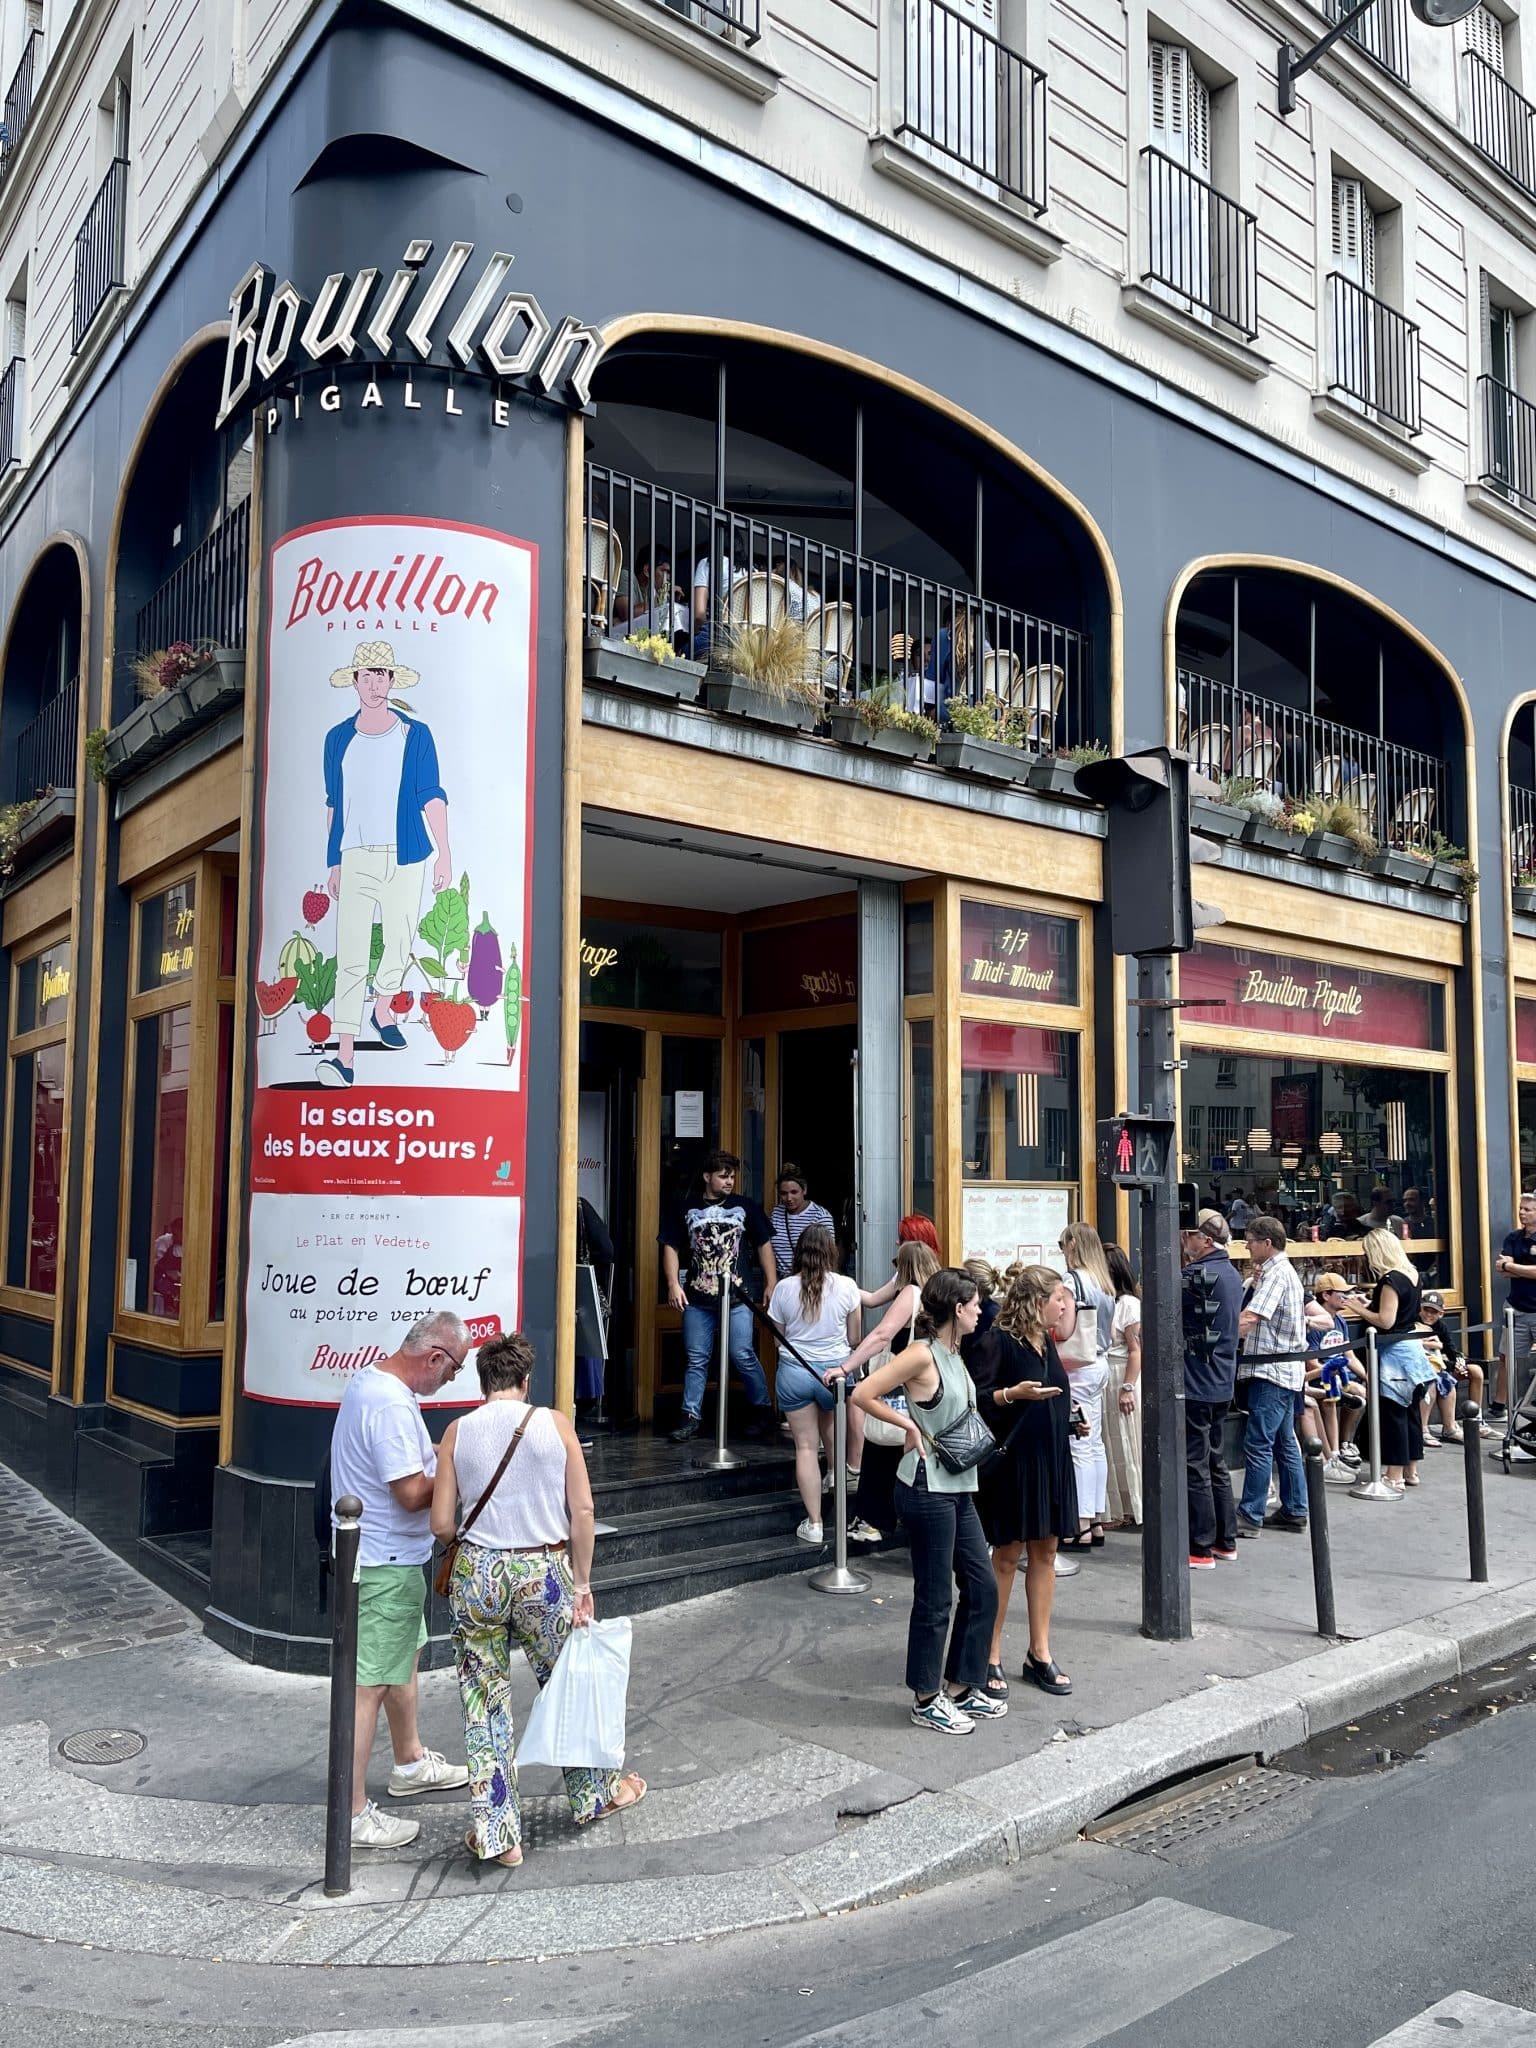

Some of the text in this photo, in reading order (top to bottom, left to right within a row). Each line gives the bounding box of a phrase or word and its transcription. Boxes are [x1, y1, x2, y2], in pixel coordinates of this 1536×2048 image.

[215, 240, 605, 431] Bouillon
[267, 382, 510, 434] PIGALLE
[285, 554, 499, 631] Bouillon
[327, 619, 438, 632] PIGALLE
[1001, 928, 1029, 955] 7/7
[579, 938, 618, 977] tage
[971, 958, 1054, 991] Midi-Minuit
[1241, 969, 1363, 1027] Bouillon Pigalle
[300, 1101, 435, 1127] la saison
[263, 1133, 294, 1157] des
[300, 1132, 390, 1158] beaux
[395, 1133, 477, 1165] jours
[577, 1157, 601, 1170] uillon
[296, 1234, 431, 1250] Le Plat en Vedette
[261, 1264, 492, 1302] Joue de bœuf
[289, 1305, 307, 1320] au
[315, 1306, 379, 1324] poivre
[470, 1321, 496, 1340] 80€
[310, 1344, 388, 1371] Bouill
